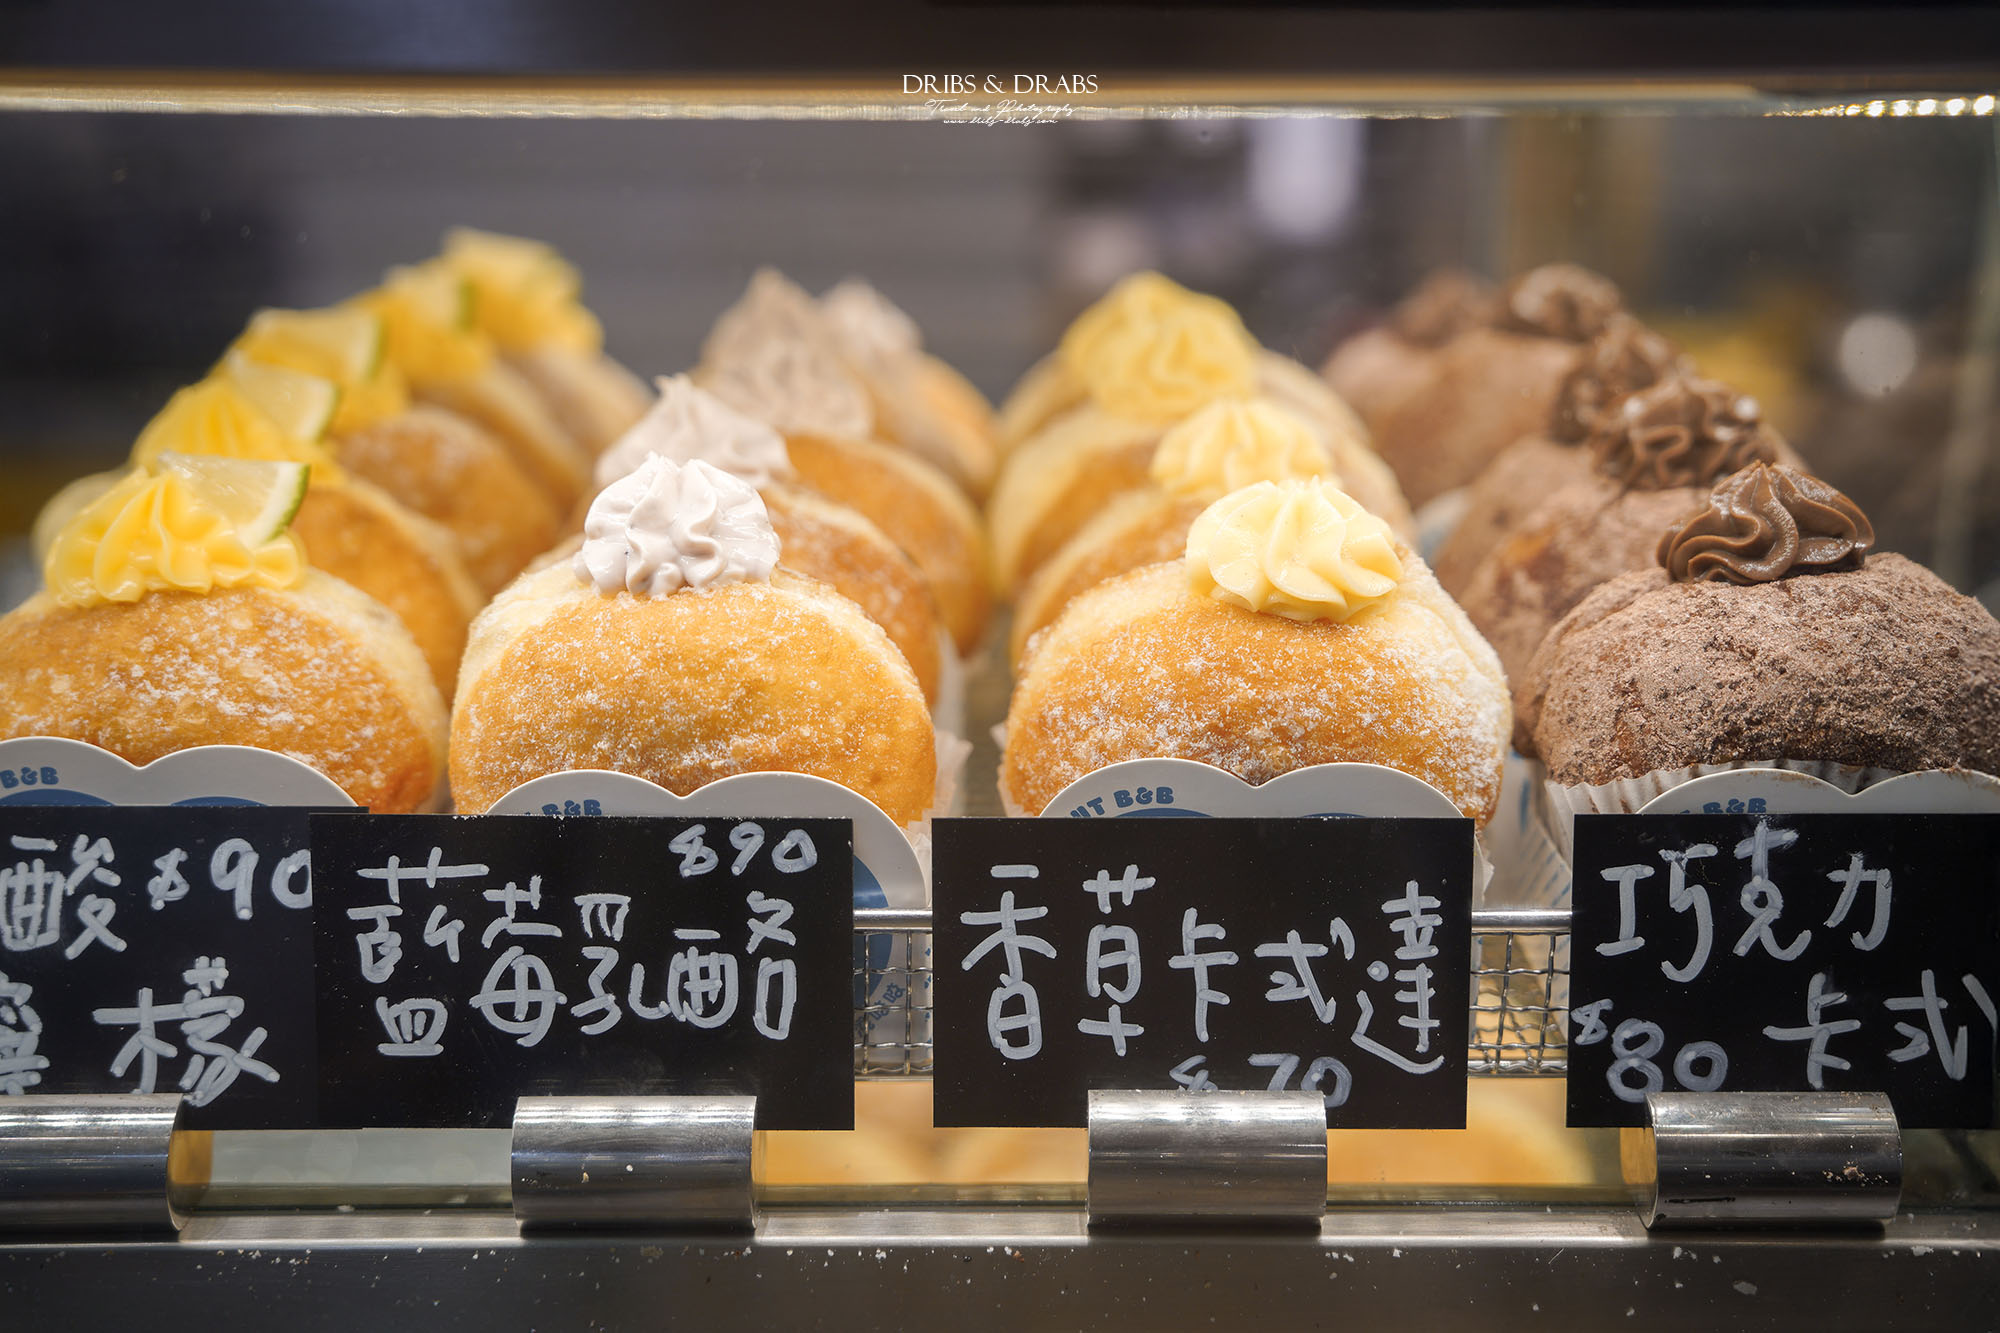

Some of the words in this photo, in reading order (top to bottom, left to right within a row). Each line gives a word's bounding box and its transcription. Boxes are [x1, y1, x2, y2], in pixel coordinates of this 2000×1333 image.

[0, 766, 59, 789] B&B
[1113, 786, 1174, 808] B&B
[147, 838, 313, 920] $90
[669, 821, 817, 877] $90
[1595, 819, 1892, 983] 巧克力
[1570, 997, 1729, 1103] $80
